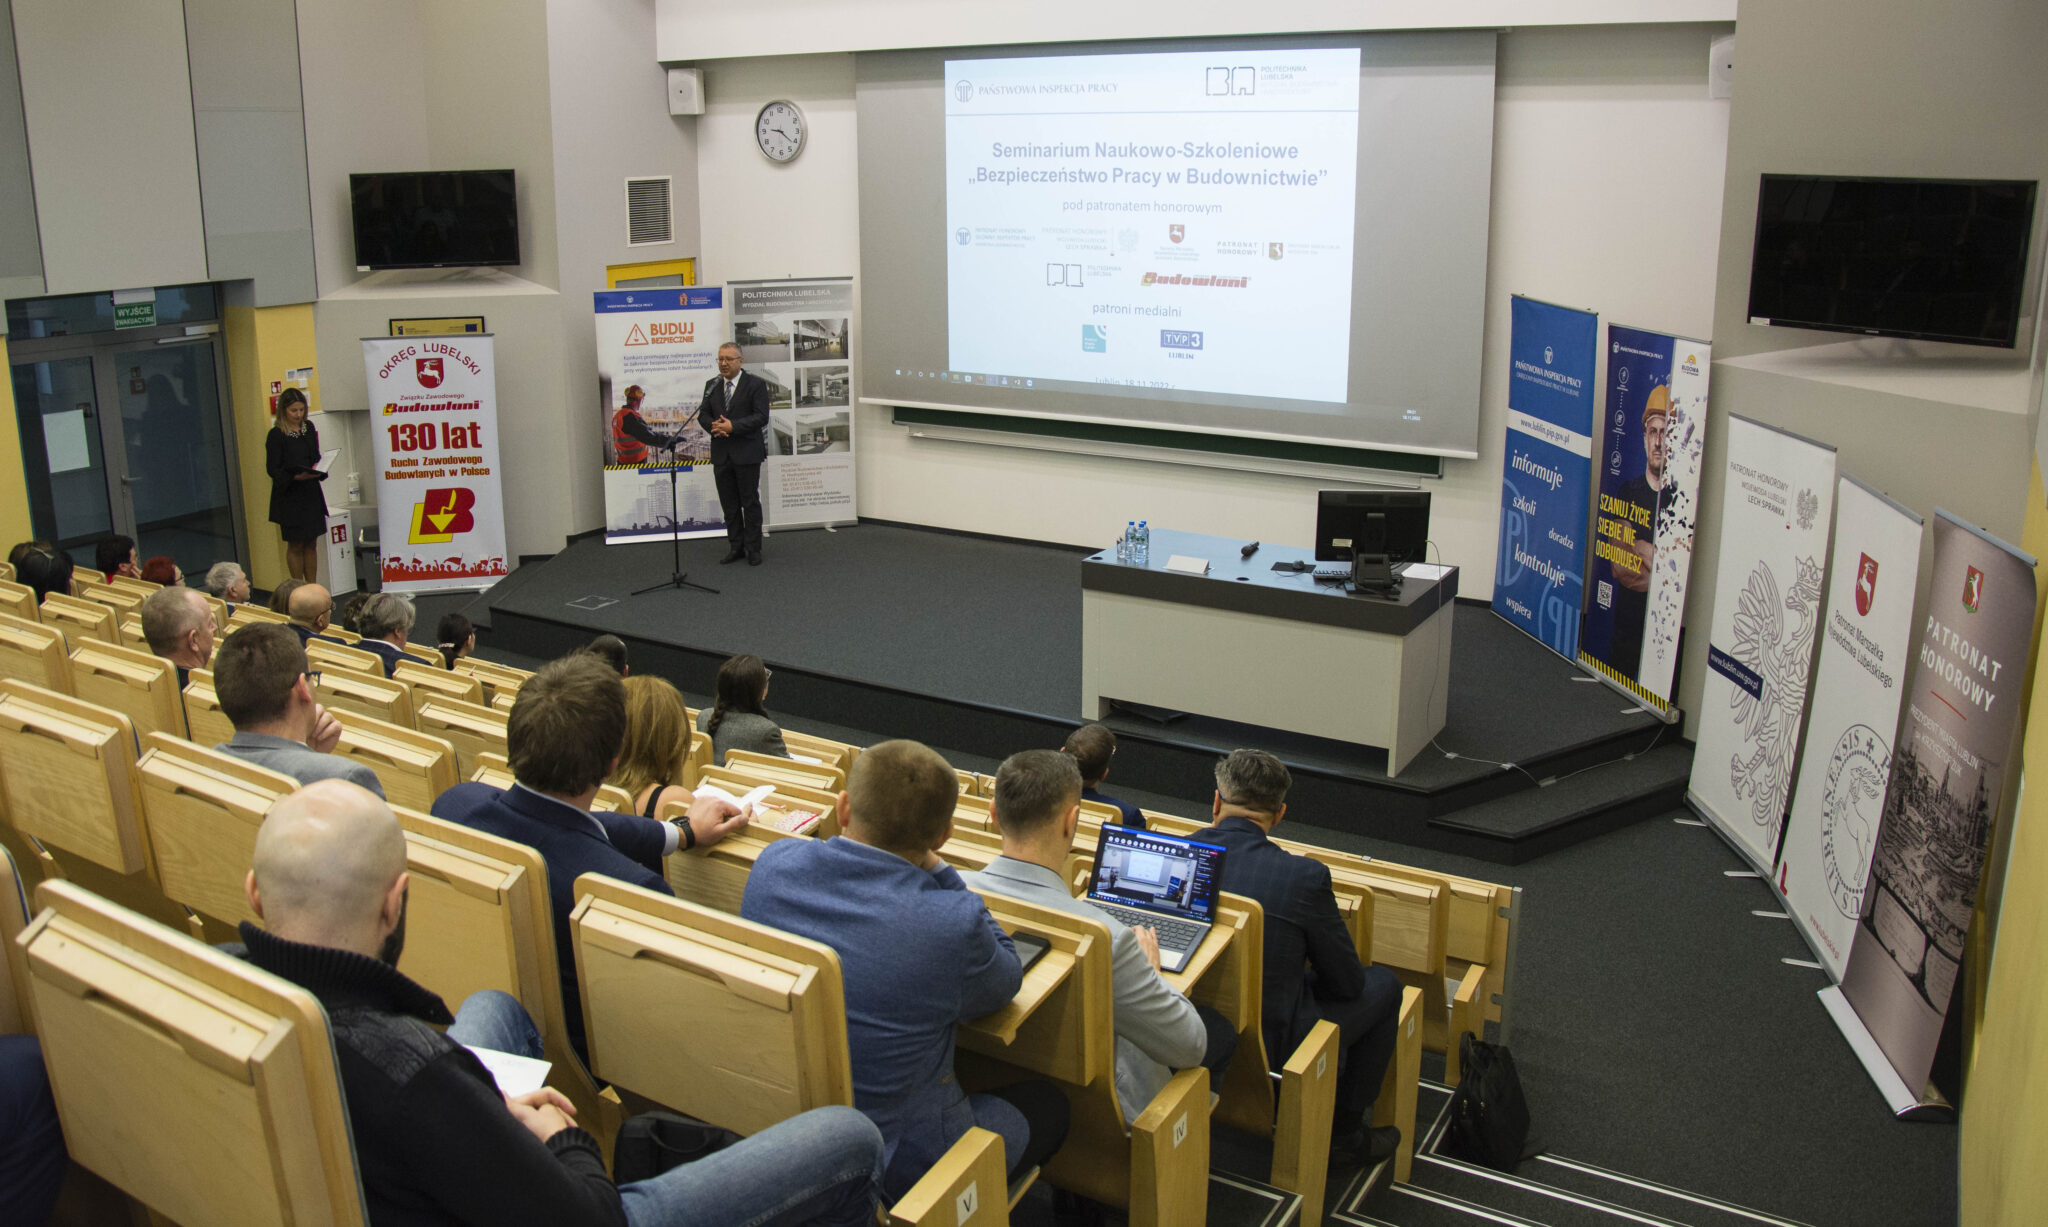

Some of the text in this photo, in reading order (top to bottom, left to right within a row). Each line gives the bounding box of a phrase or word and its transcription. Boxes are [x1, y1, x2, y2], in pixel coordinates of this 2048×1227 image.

[979, 82, 1119, 97] PAŃSTWOWA INSPEKCJA PRACY
[992, 141, 1299, 161] Seminarium Naukowo-Szkoleniowe
[968, 166, 1328, 188] „Bezpieczeństwo Pracy w Budownictwie”
[1062, 201, 1223, 216] pod patronatem honorowym
[1143, 272, 1247, 288] Budowlani
[742, 288, 831, 299] POLITECHNIKA LUBELSKA
[117, 306, 153, 317] WYJŚCIE
[1093, 303, 1182, 317] patroni medialni
[650, 322, 694, 336] BUDUJ
[1165, 333, 1201, 347] TVP 3
[651, 336, 694, 345] BEZPIECZNIE
[379, 343, 481, 379] OKRĘG LUBELSKI
[1168, 352, 1194, 360] LUBLIN
[1514, 360, 1582, 389] PAŃSTWOWA INSPEKCJA PRACY
[384, 400, 480, 415] Budowlani
[387, 421, 482, 452] 130 lat
[1520, 419, 1570, 444] www.lublin.pip.gov.pl
[391, 456, 482, 467] Ruchu Zawodowego
[1512, 449, 1563, 491] informuje
[385, 468, 445, 480] Budowlanych
[461, 467, 490, 476] Polsce
[1730, 461, 1788, 493] PATRONAT HONOROWY
[1512, 496, 1537, 516] szkoli
[1600, 493, 1652, 530] SZANUJ ŻYCIE,
[1747, 495, 1784, 517] LECH SPRAWKA
[1548, 528, 1574, 549] doradza
[1598, 516, 1637, 546] SIEBIE NIE
[1514, 544, 1566, 588] kontroluje
[1595, 539, 1642, 574] ODBUDUJESZ
[1506, 596, 1532, 620] wspiera
[1835, 609, 1884, 662] Patronat Marszałka
[1926, 615, 2002, 682] PATRONAT
[1710, 653, 1759, 691] www.lublin.uw.gov.pl
[1857, 649, 1893, 689] Lubelskiego
[1920, 643, 1996, 712] HONOROWY
[1911, 703, 1979, 770] PREZYDENT MIASTA LUBLIN
[1921, 735, 1952, 765] KRZYSZTOF
[1176, 1121, 1184, 1141] IV
[963, 1192, 972, 1212] V
